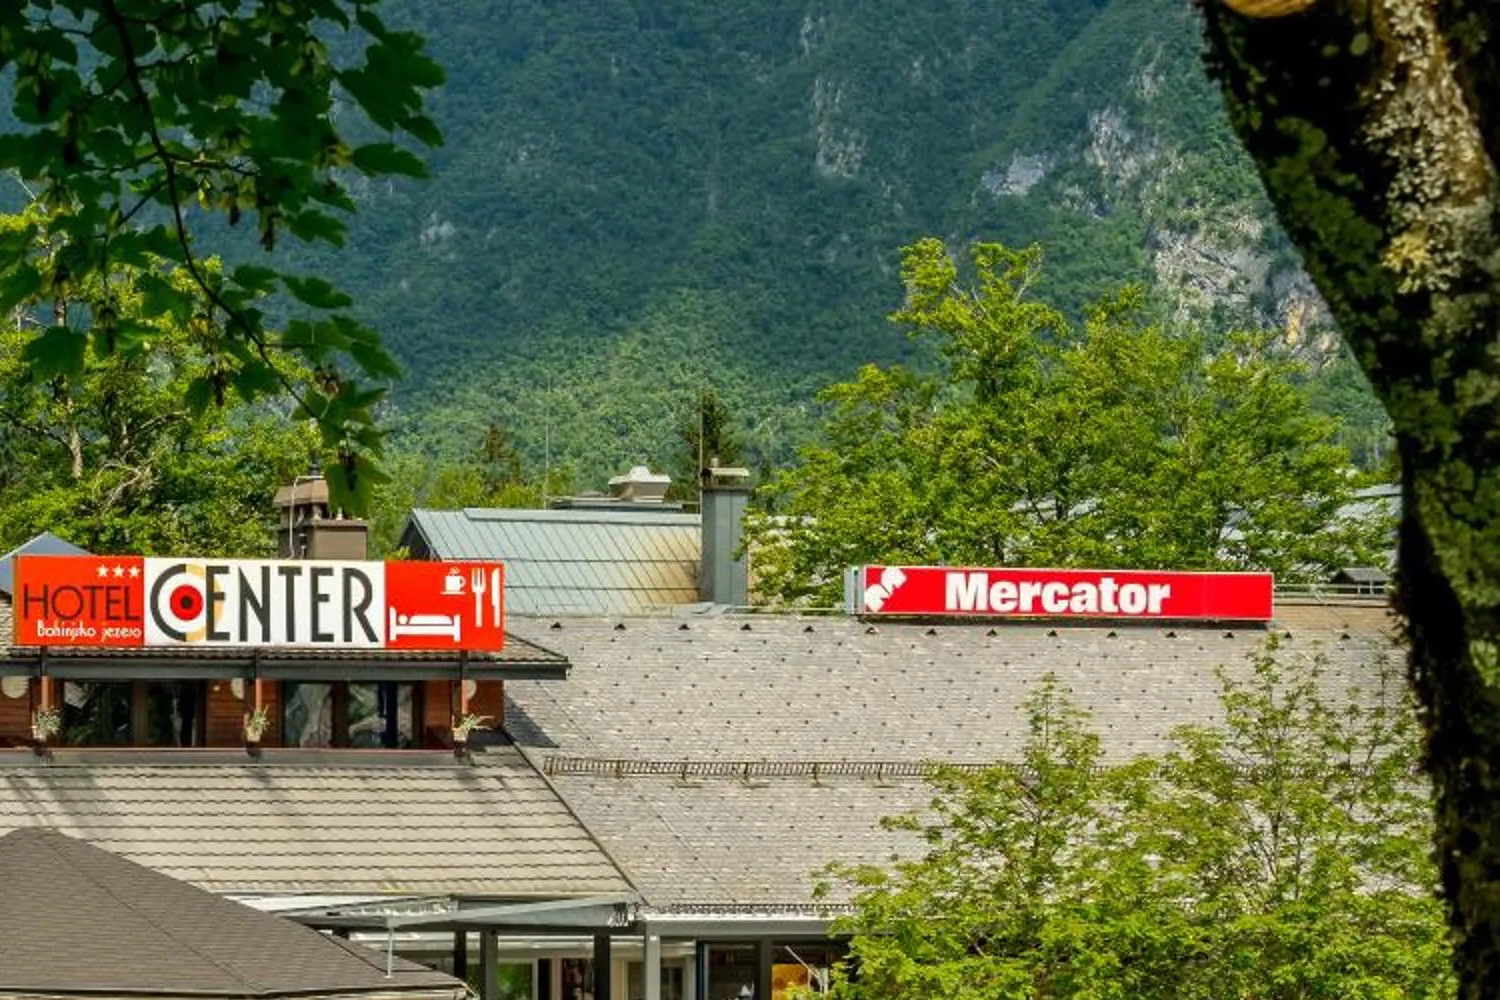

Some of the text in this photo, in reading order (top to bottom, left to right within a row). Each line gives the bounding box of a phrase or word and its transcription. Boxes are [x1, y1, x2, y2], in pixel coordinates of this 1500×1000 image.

[23, 585, 141, 621] HOTEL
[150, 564, 379, 643] CENTER
[945, 572, 1172, 615] Mercator
